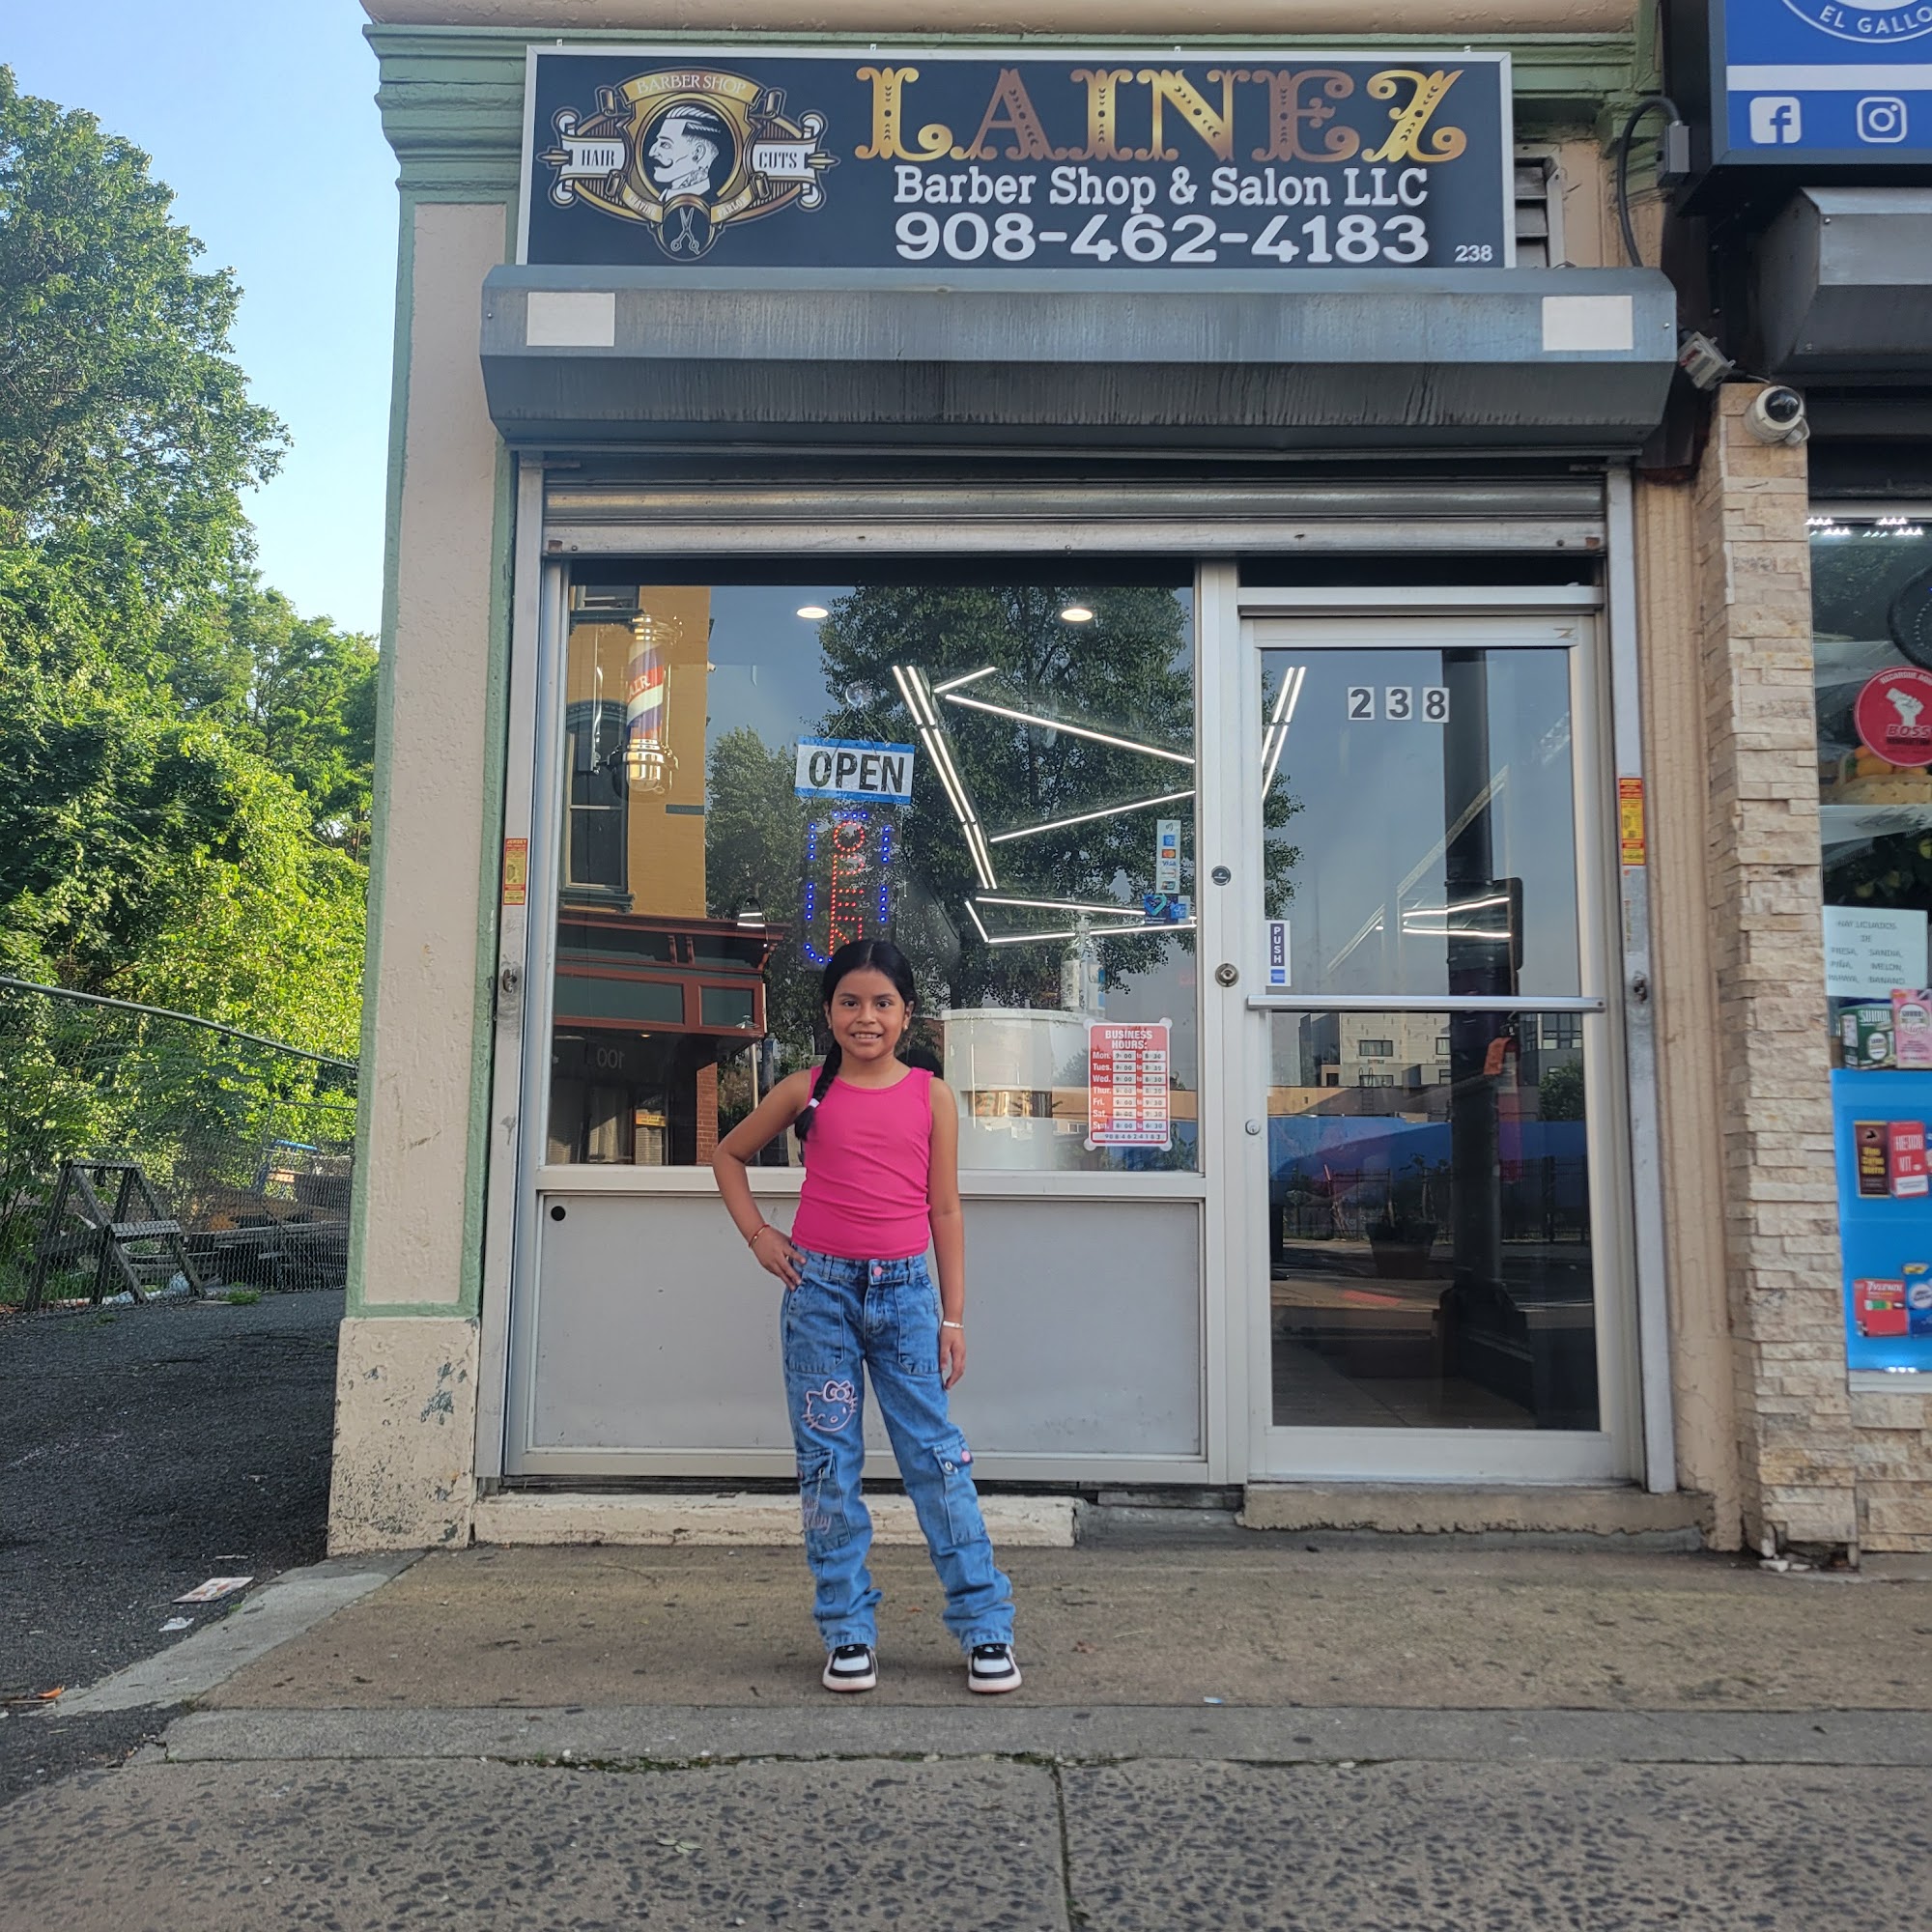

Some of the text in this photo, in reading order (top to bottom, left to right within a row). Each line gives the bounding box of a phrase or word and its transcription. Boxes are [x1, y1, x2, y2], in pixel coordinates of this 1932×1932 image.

[1819, 5, 1932, 35] EL GALLO
[636, 73, 747, 95] BARBER SHOP
[854, 66, 1467, 163] LAINEZ
[581, 150, 615, 168] HAIR
[758, 150, 798, 169] CUTS
[893, 165, 1428, 213] Barber Shop & Salon LLC
[627, 194, 657, 216] SHAVING
[717, 195, 748, 218] PARLOR
[895, 211, 1430, 263] 908-462-4183
[1455, 244, 1493, 263] 238
[1887, 724, 1929, 738] BOSS
[809, 751, 905, 793] OPEN
[1273, 926, 1282, 963] PUSH
[1105, 1030, 1152, 1039] BUSINESS
[1112, 1040, 1148, 1049] HOURS:
